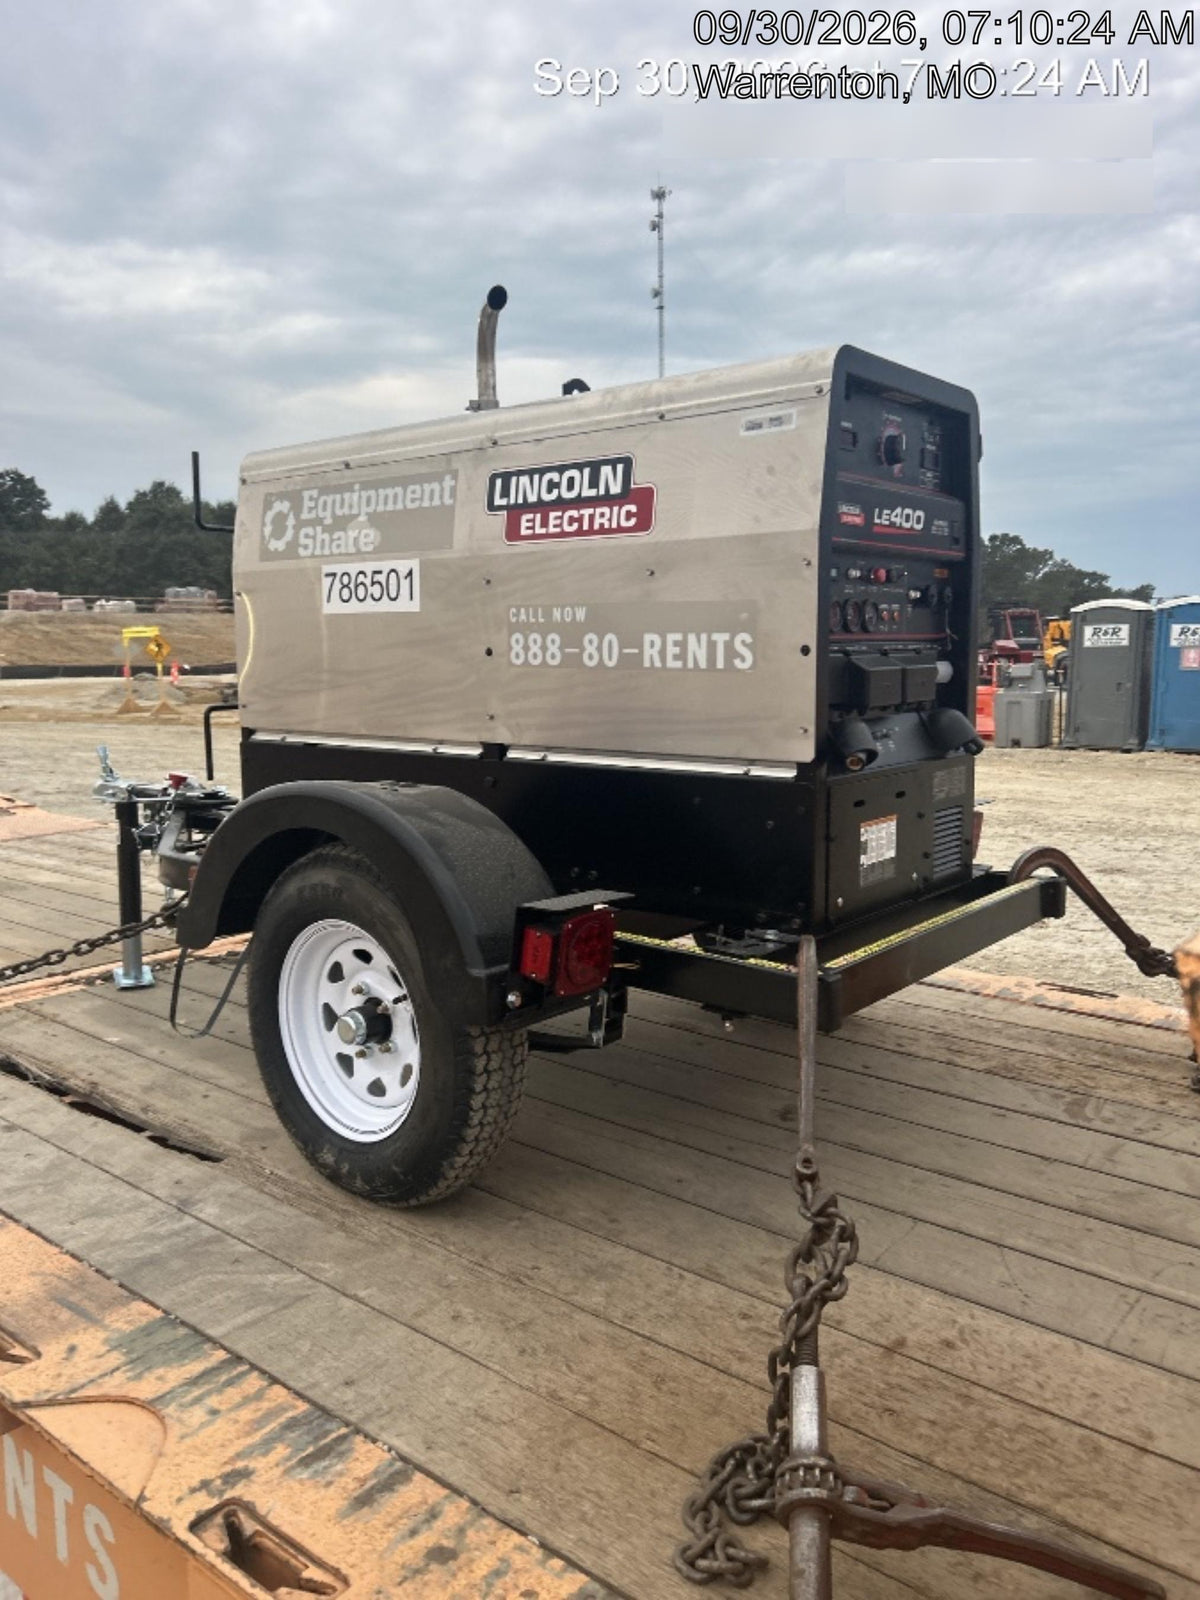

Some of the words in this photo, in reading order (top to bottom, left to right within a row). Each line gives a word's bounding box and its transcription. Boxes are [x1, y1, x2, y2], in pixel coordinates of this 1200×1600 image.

[300, 474, 456, 525] Equipment
[494, 462, 624, 507] LINCOLN
[519, 504, 638, 536] ELECTRIC
[874, 506, 925, 531] LE400
[297, 524, 376, 558] Share
[324, 567, 415, 604] 786501
[509, 606, 545, 623] CALL
[552, 606, 587, 623] NOW
[1092, 626, 1122, 638] R&R
[509, 632, 754, 670] 888-80-RENTS
